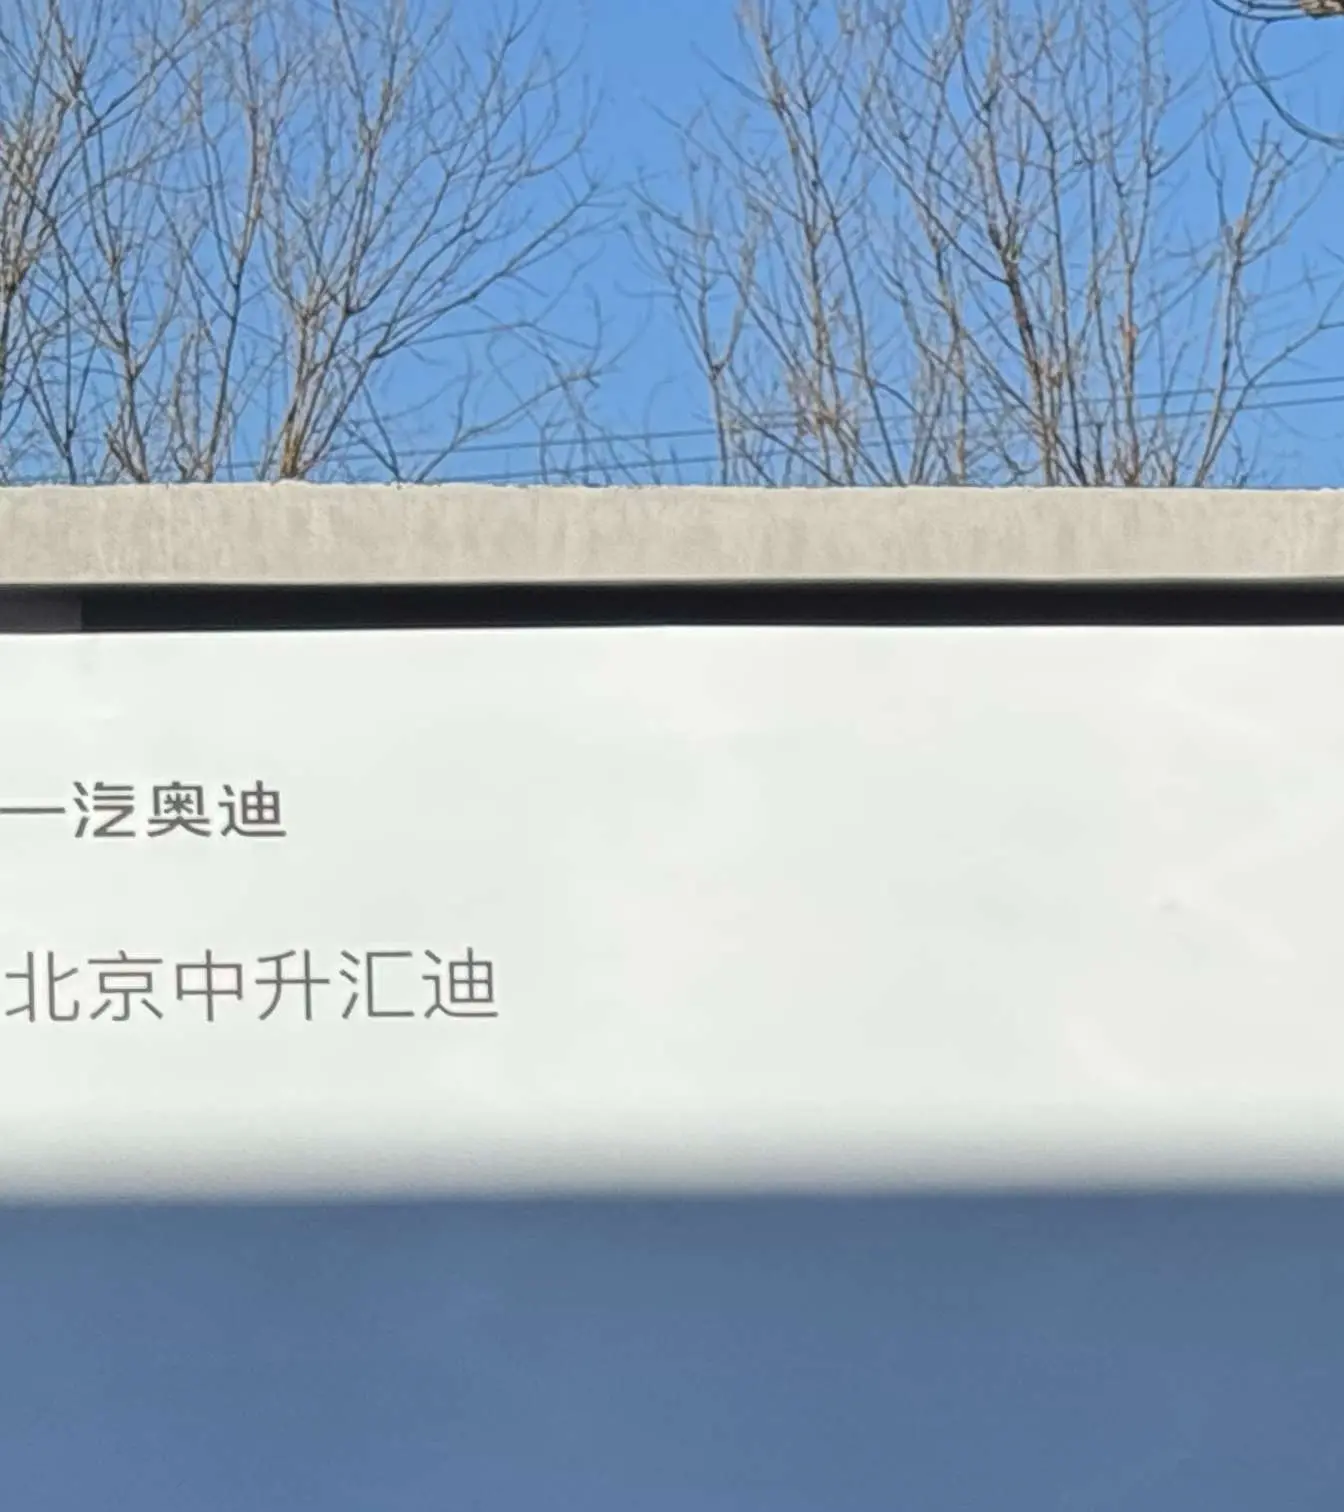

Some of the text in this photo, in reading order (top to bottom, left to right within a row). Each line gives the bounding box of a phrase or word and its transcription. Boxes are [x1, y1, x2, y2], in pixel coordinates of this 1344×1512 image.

[0, 780, 288, 838] 一汽奥迪
[4, 947, 499, 1022] 北京中升汇迪
